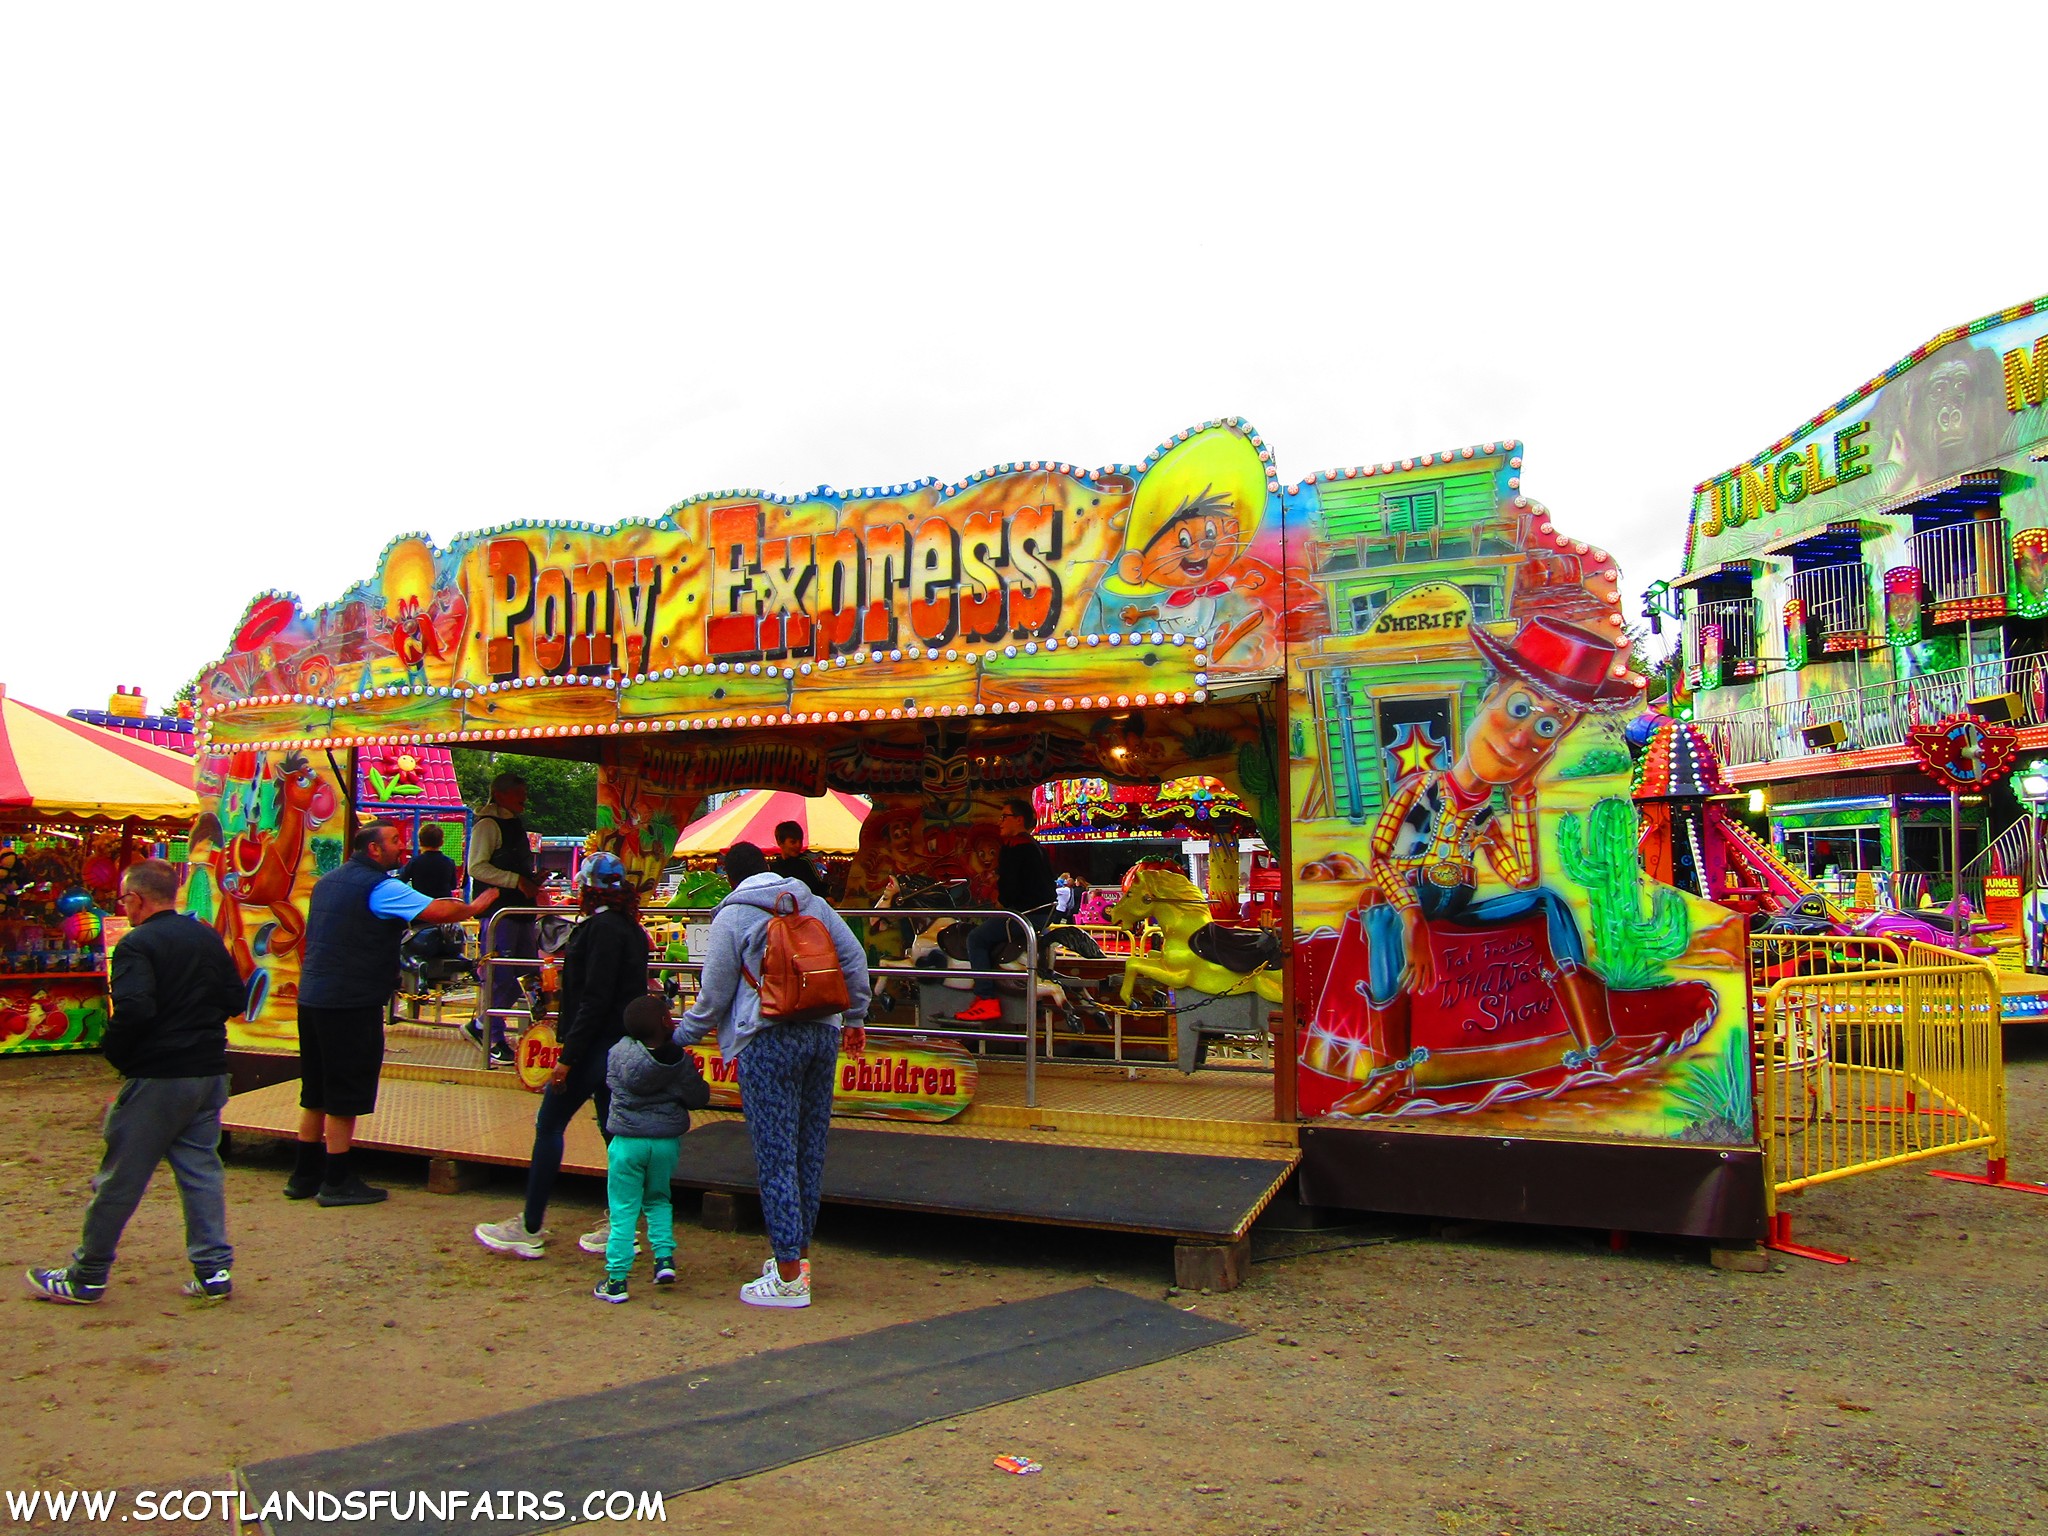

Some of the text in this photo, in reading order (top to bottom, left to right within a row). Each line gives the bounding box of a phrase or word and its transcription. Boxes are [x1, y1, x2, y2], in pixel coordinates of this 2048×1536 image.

[1700, 422, 1871, 537] JUNGLE
[487, 501, 1062, 684] Pony Express
[1375, 609, 1467, 633] SHERIFF
[693, 743, 818, 794] ADVENTURE
[1985, 878, 2018, 888] JUNGLE
[1985, 889, 2020, 897] MADNESS
[1442, 946, 1472, 970] Fat
[1440, 951, 1544, 1008] Wild West
[1461, 994, 1553, 1031] Show
[841, 1057, 957, 1096] children
